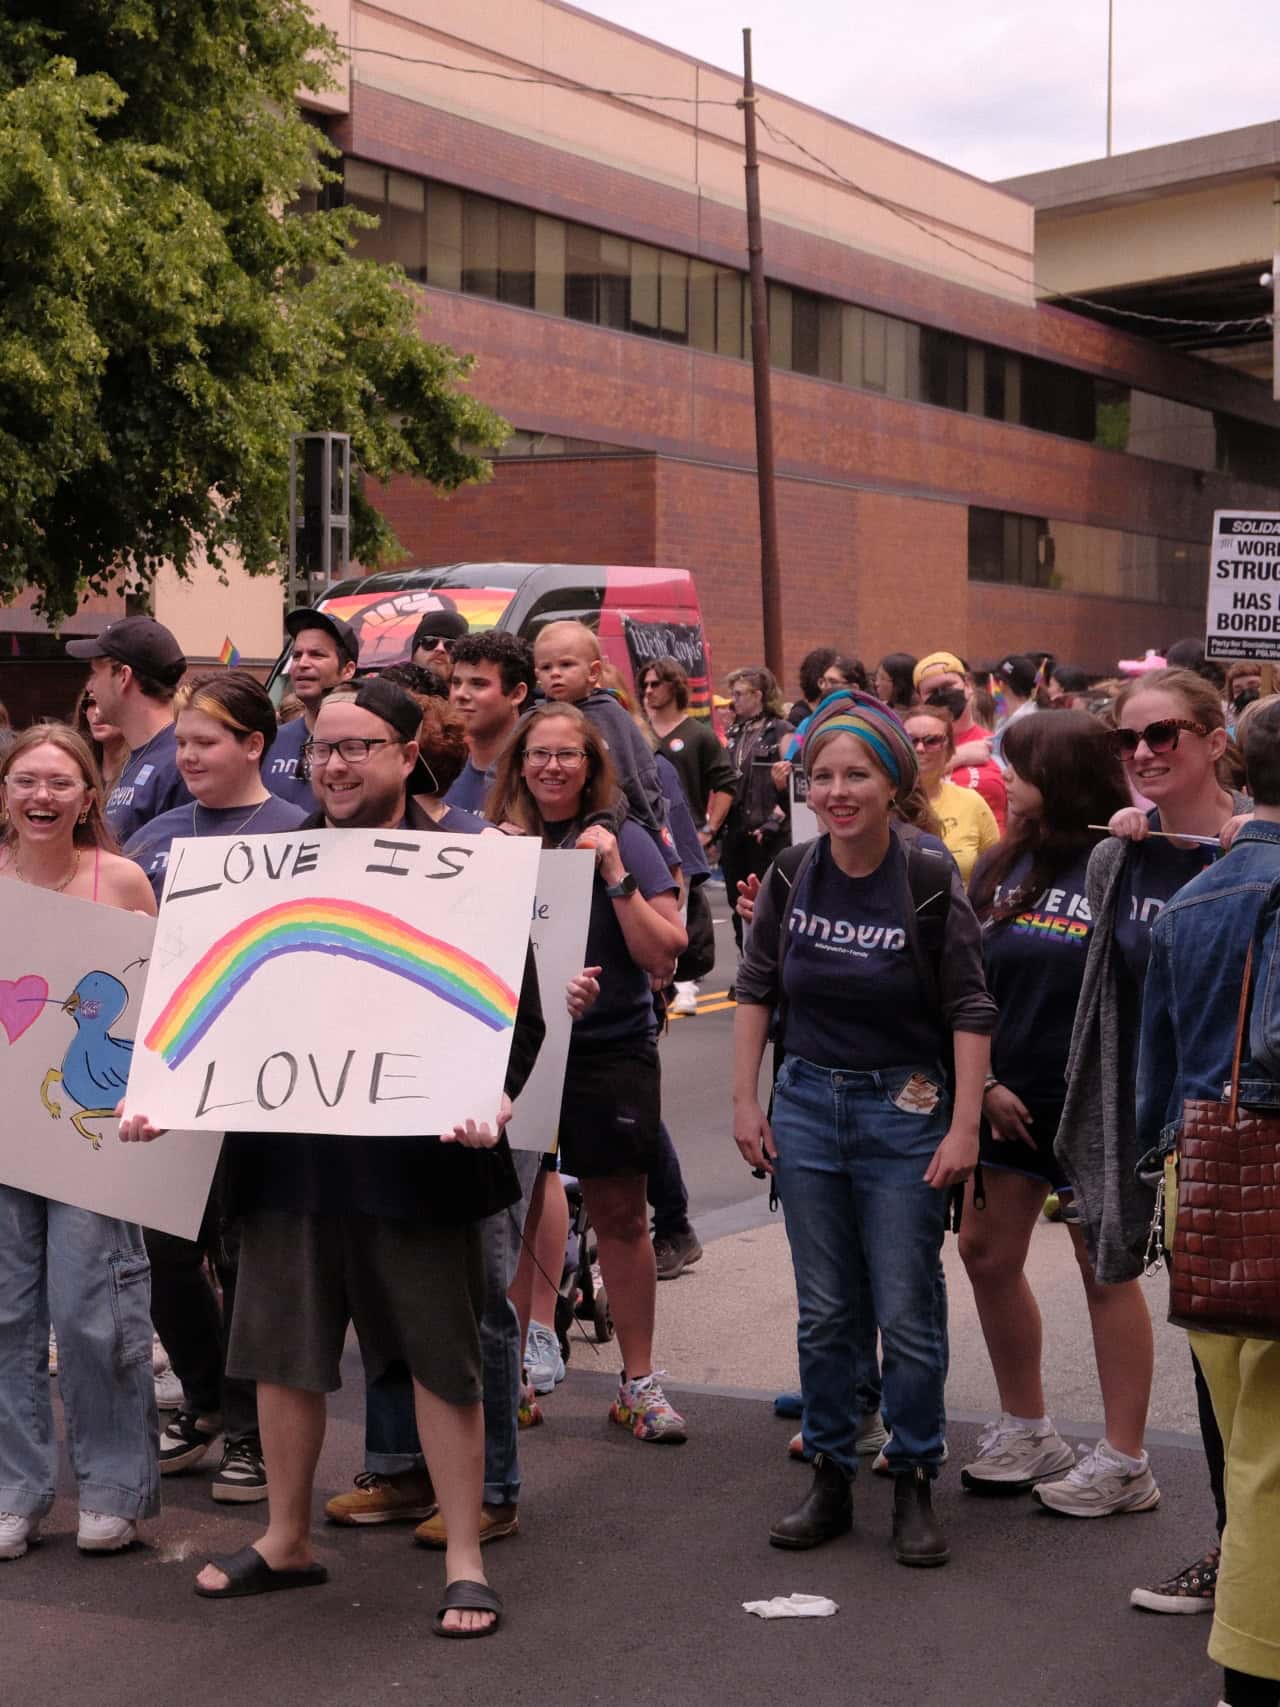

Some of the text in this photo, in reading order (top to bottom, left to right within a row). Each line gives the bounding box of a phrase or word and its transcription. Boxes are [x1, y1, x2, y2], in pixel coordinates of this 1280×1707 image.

[1238, 540, 1280, 556] WOR
[1233, 592, 1272, 611] HAS
[1217, 613, 1280, 633] BORDE
[166, 839, 474, 903] LOVE IS
[788, 908, 906, 951] משפחה
[1012, 912, 1089, 944] SHER
[195, 1050, 431, 1118] LOVE
